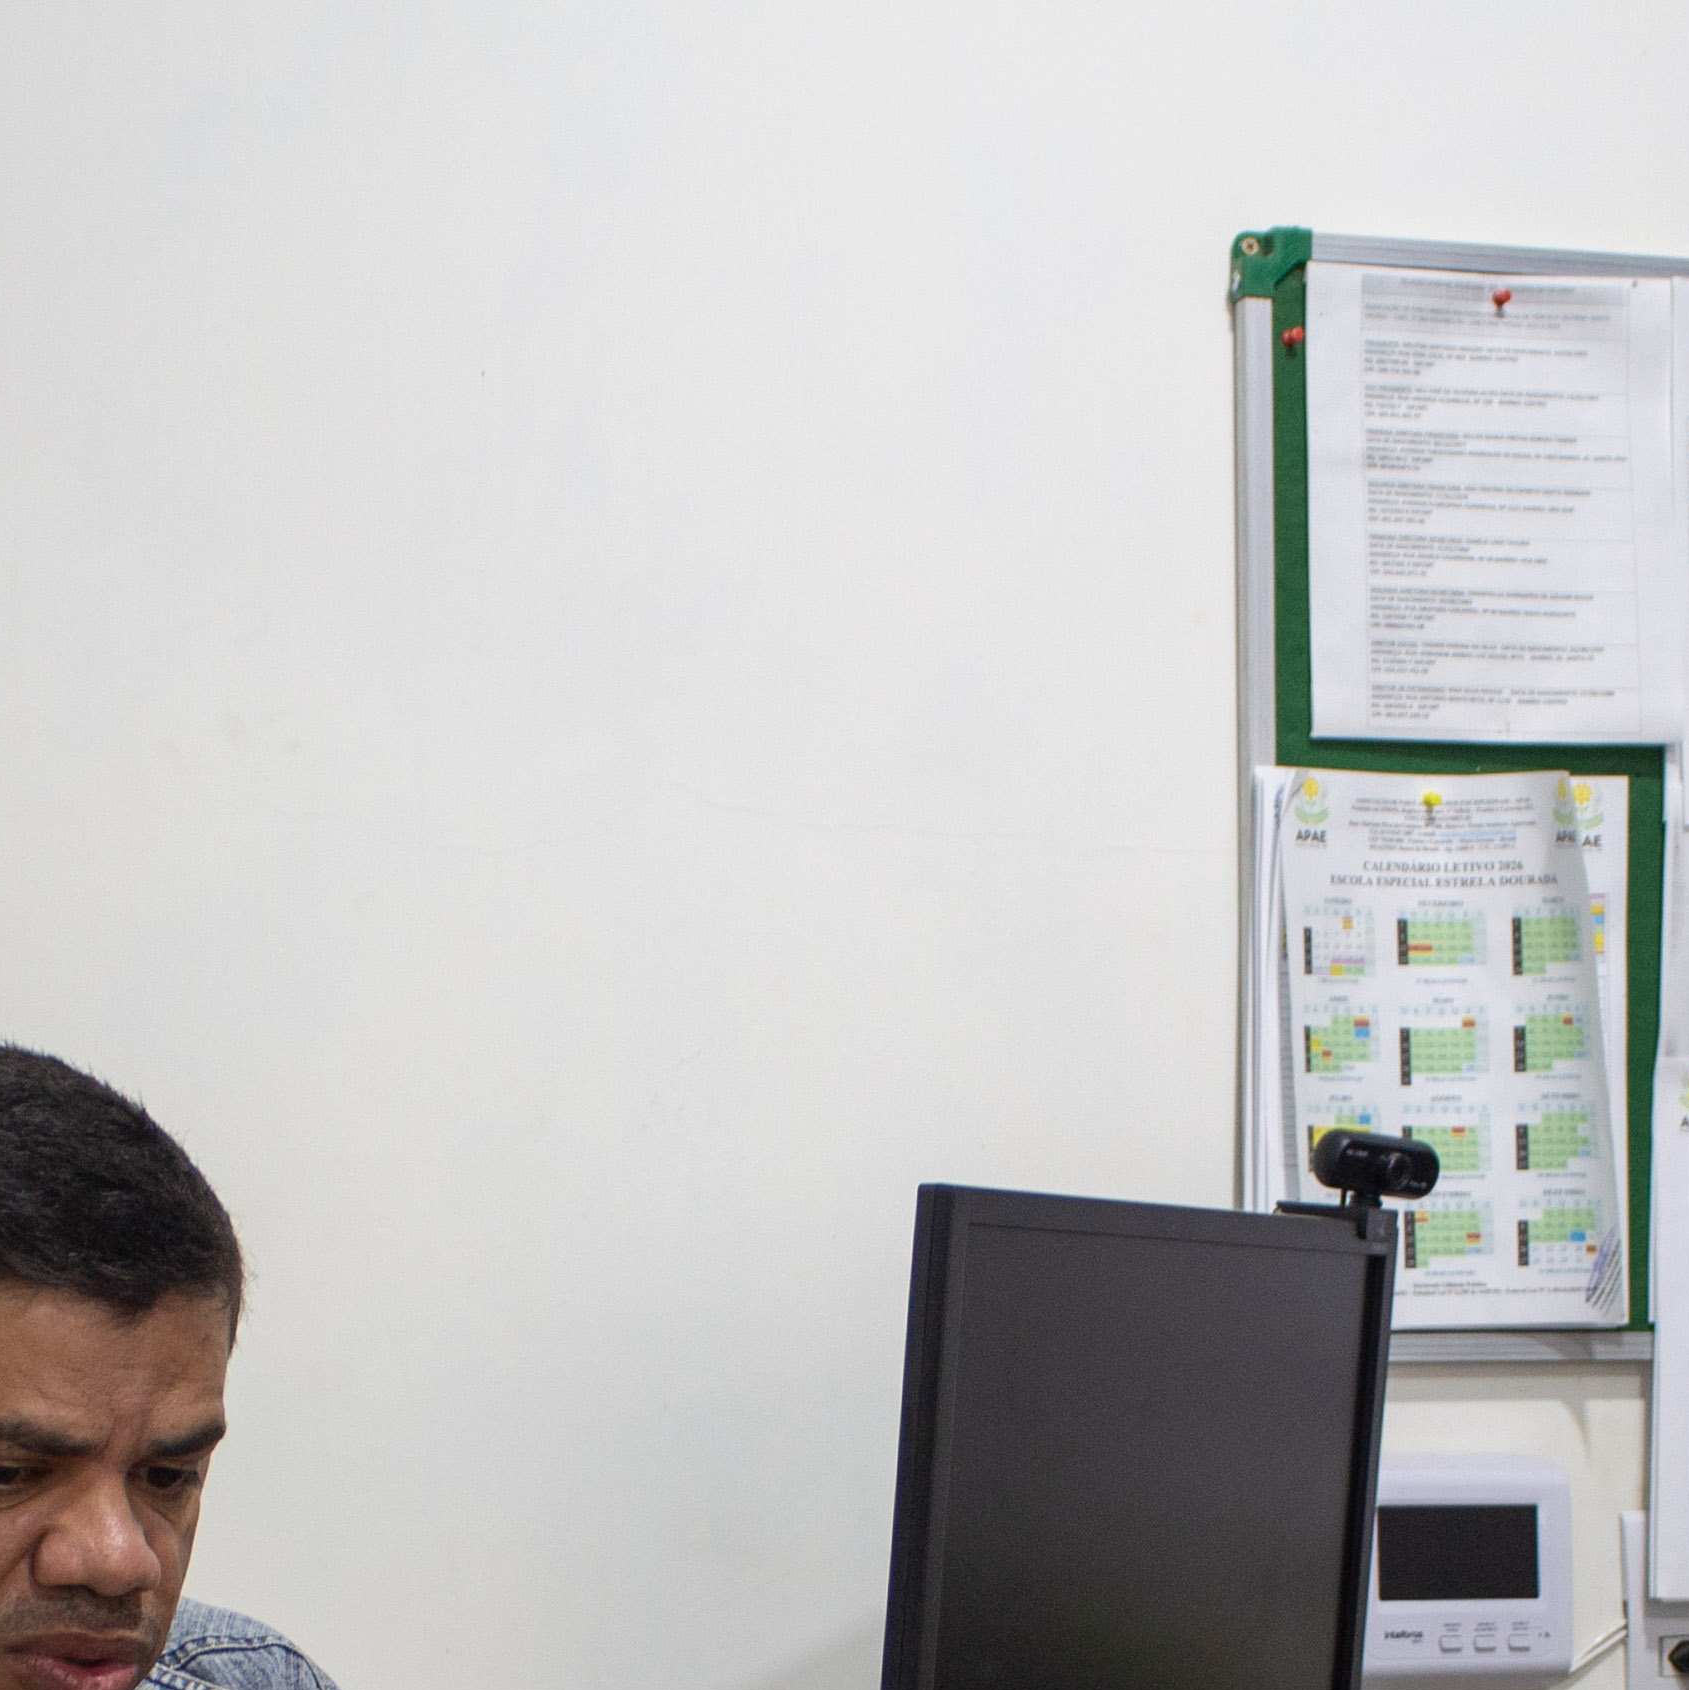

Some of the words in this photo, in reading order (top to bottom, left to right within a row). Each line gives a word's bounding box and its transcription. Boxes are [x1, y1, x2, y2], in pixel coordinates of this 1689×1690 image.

[1295, 829, 1328, 844] APAE
[1362, 858, 1440, 872] CALENDÁRIO
[1444, 860, 1494, 872] LETIVO
[1330, 874, 1373, 887] ESCOLA
[1376, 875, 1430, 888] ESPECIAL
[1436, 875, 1495, 888] ESTRELA
[1499, 873, 1558, 886] DOURADA
